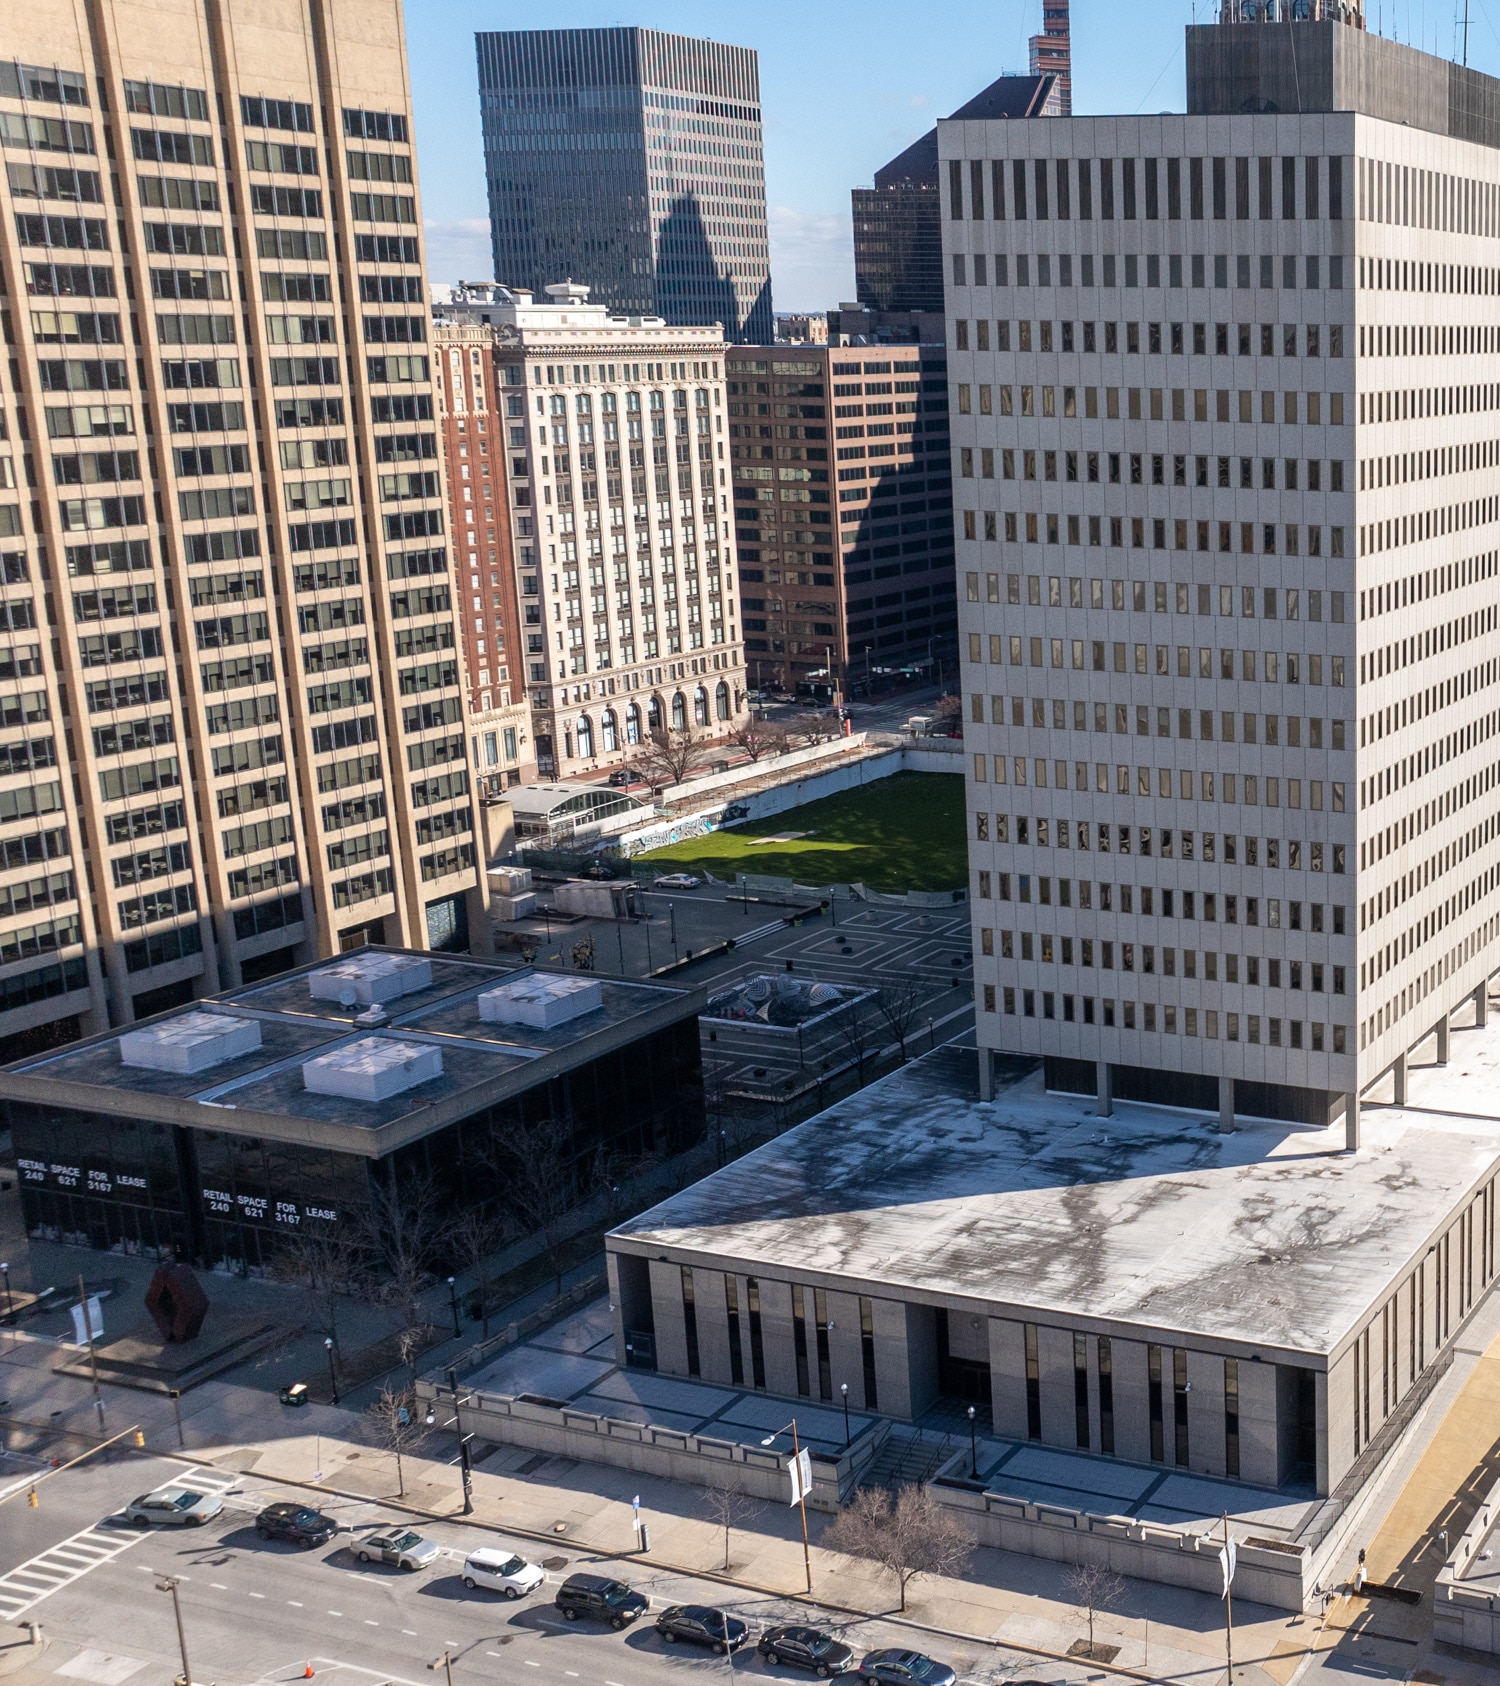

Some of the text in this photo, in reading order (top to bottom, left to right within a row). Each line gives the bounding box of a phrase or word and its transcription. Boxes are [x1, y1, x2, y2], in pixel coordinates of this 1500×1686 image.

[18, 1159, 147, 1188] RETAIL SPACE FOR LEASE
[24, 1170, 112, 1192] 240 621 3167
[203, 1189, 337, 1221] RETAIL SPACE FOR LEASE
[210, 1201, 301, 1225] 240 621 3167
